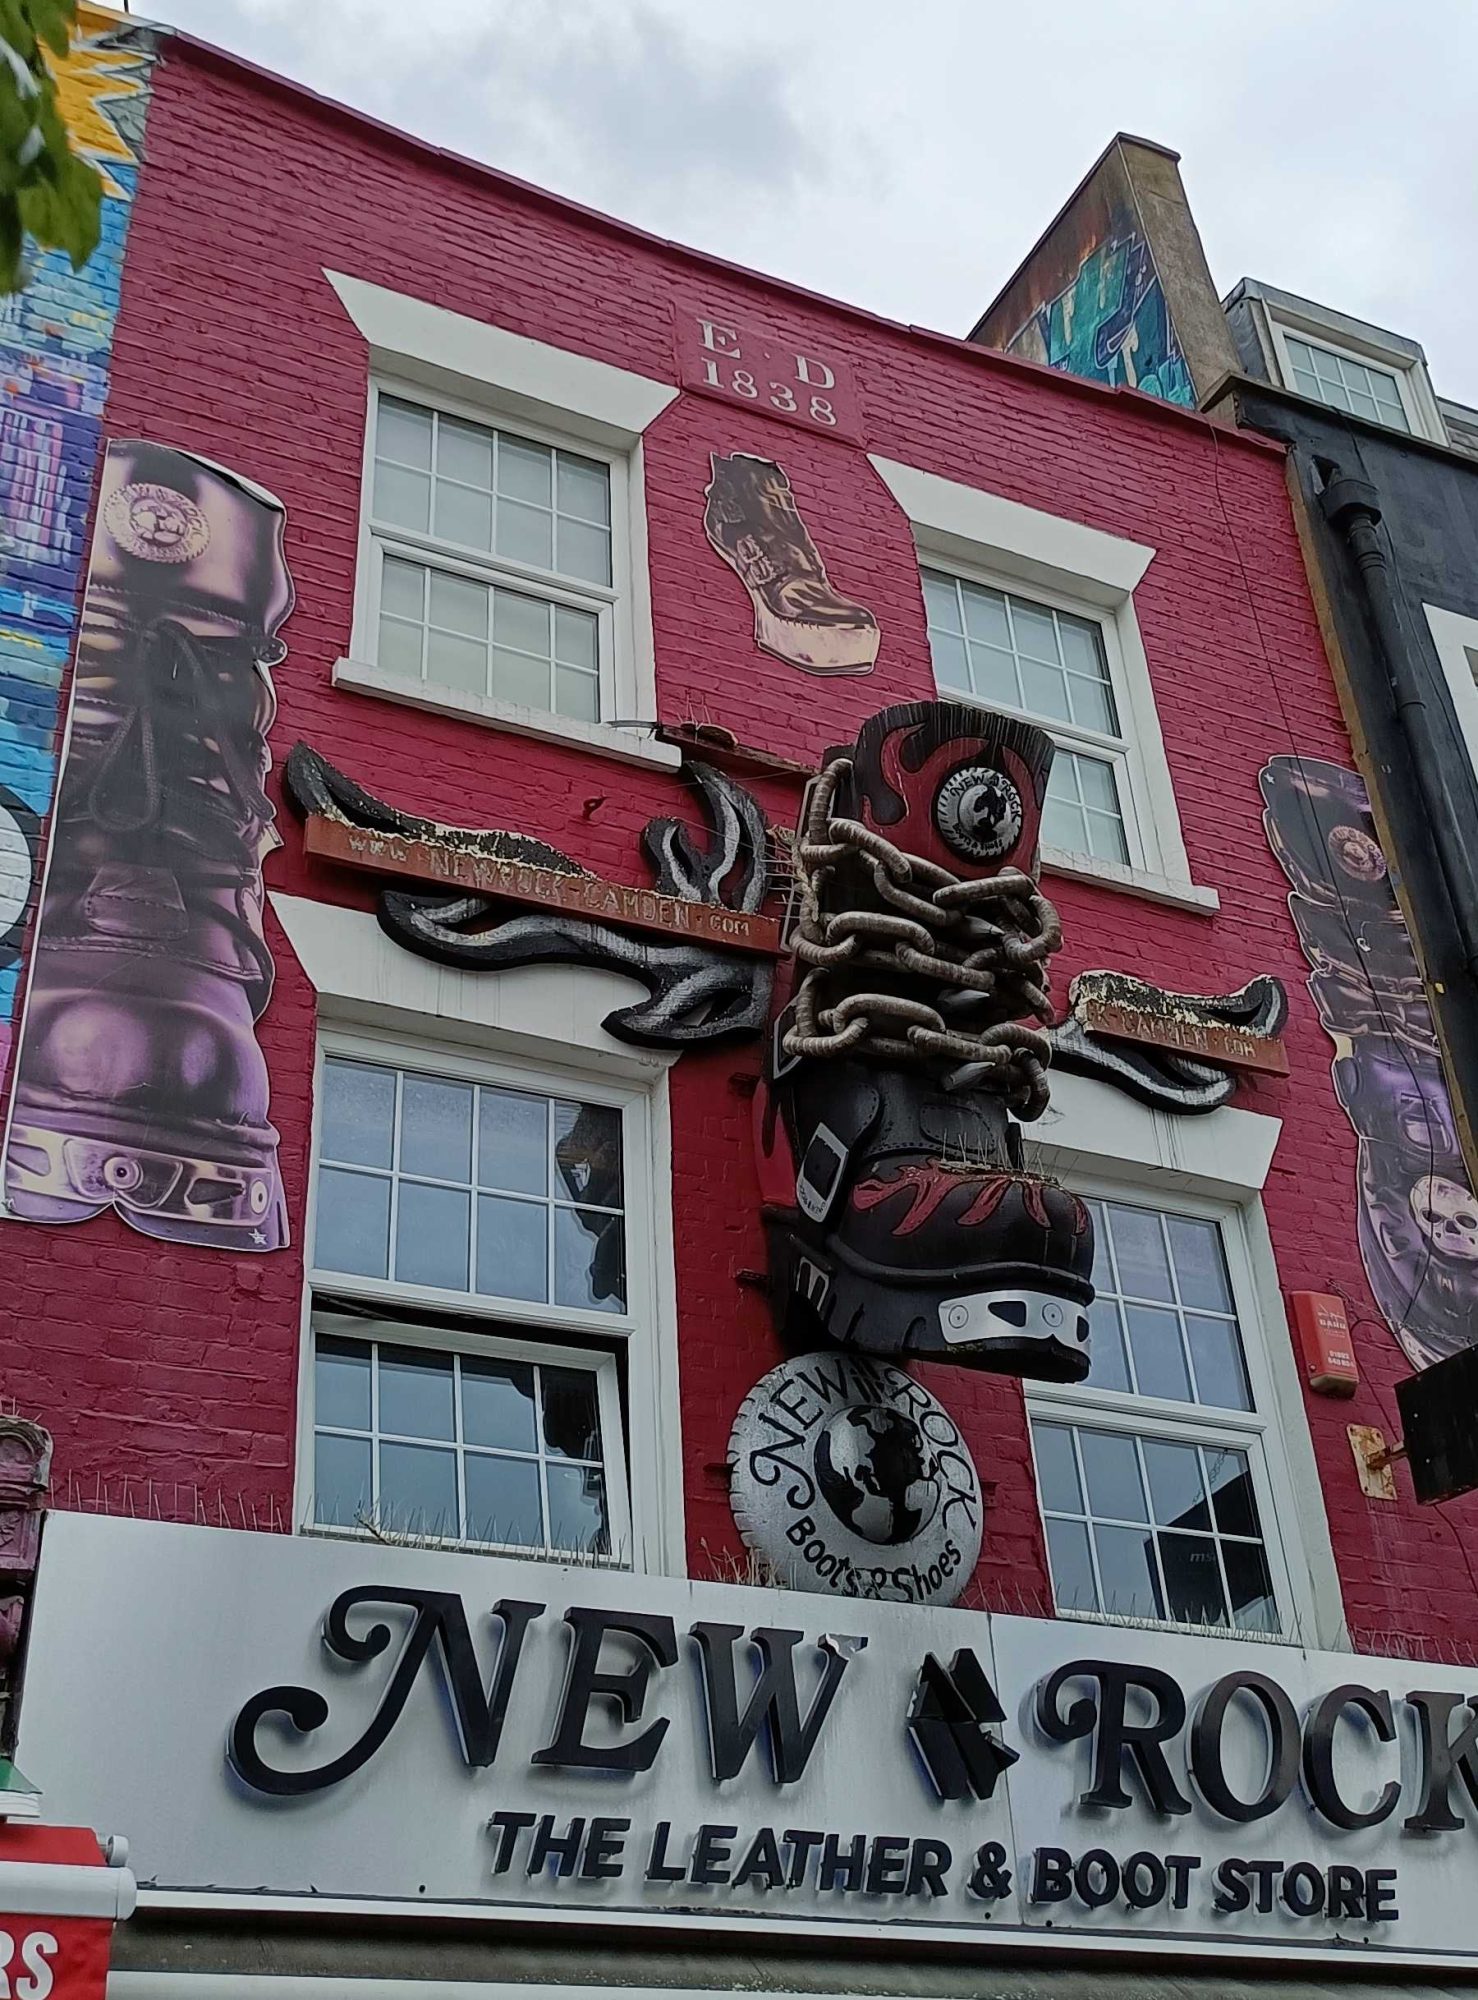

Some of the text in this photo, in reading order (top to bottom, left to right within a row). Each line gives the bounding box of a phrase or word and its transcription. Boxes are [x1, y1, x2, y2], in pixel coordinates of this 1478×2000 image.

[695, 317, 835, 389] E D
[700, 356, 837, 426] 1838
[750, 1358, 977, 1531] NEW ROCK
[227, 1584, 1478, 1830] NEW ROCK
[488, 1811, 1399, 1921] THE LEATHER & BOOT STORE
